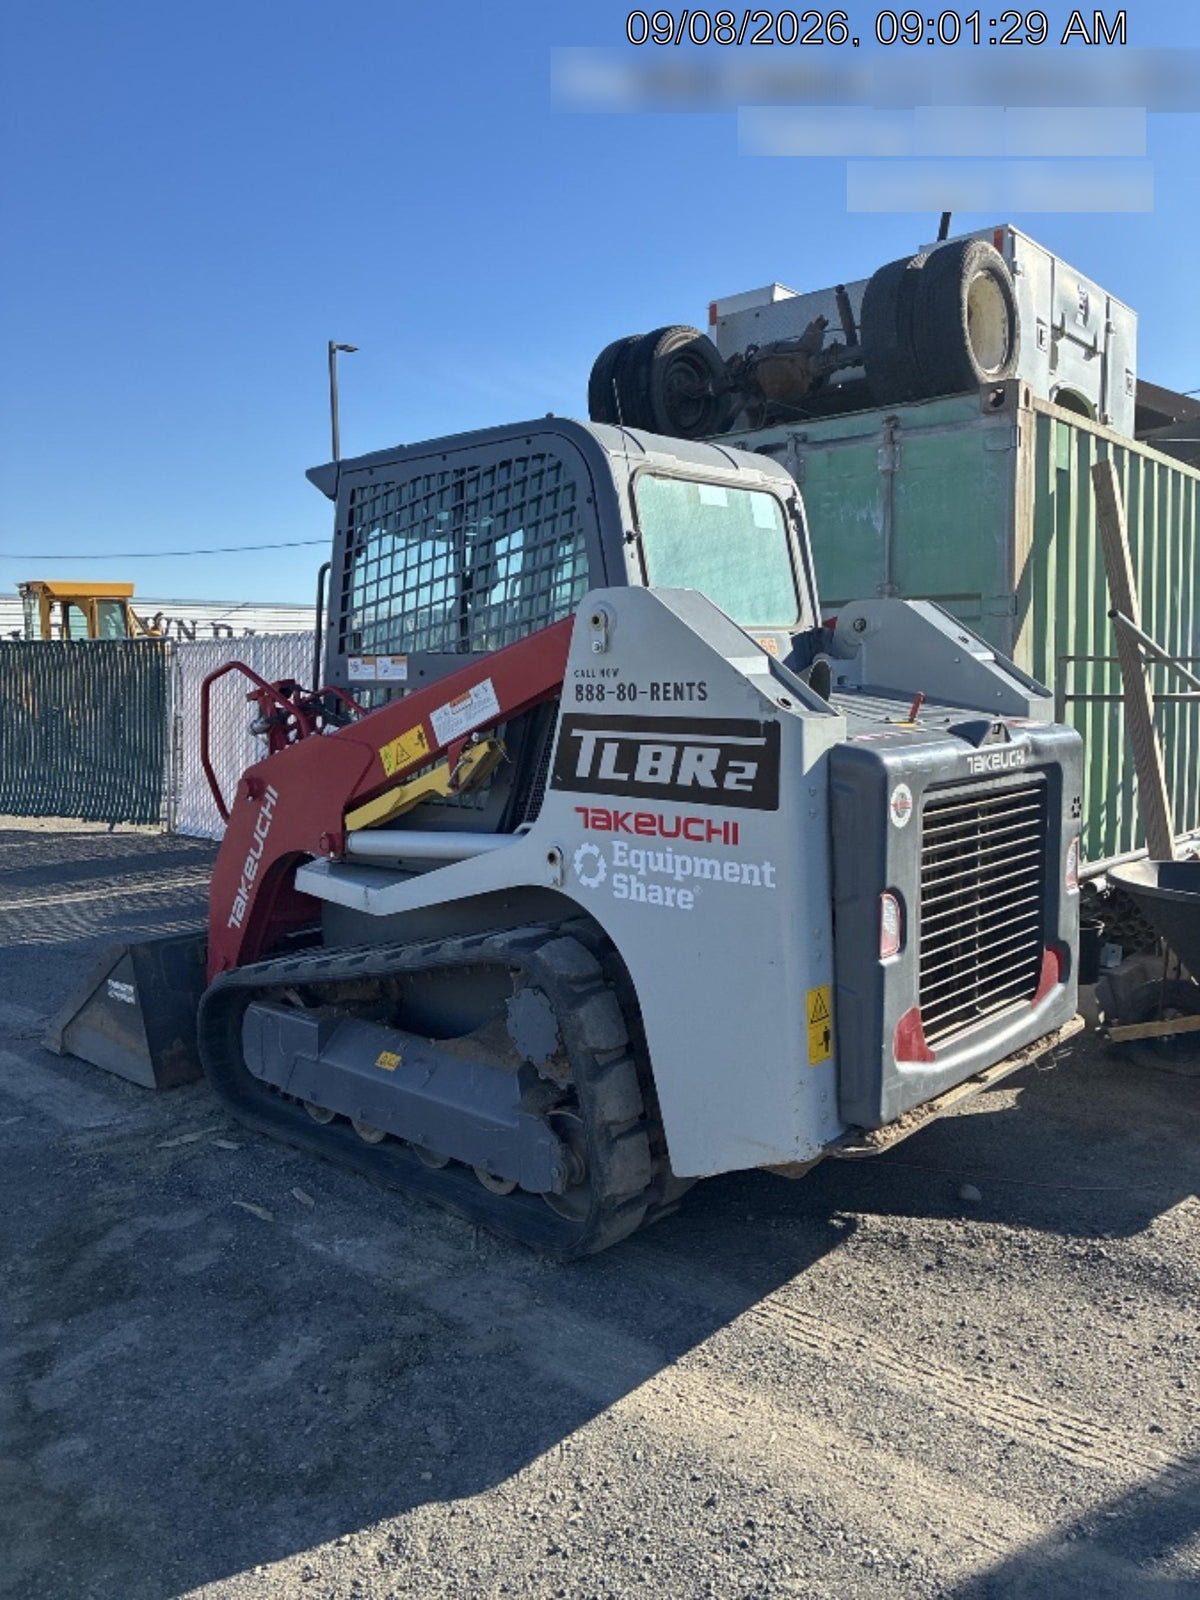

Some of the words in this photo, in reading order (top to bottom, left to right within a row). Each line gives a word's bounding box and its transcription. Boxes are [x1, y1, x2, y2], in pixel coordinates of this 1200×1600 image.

[573, 669, 597, 679] CALL
[574, 681, 708, 702] 888-80-RENTS
[611, 840, 777, 889] Equipment
